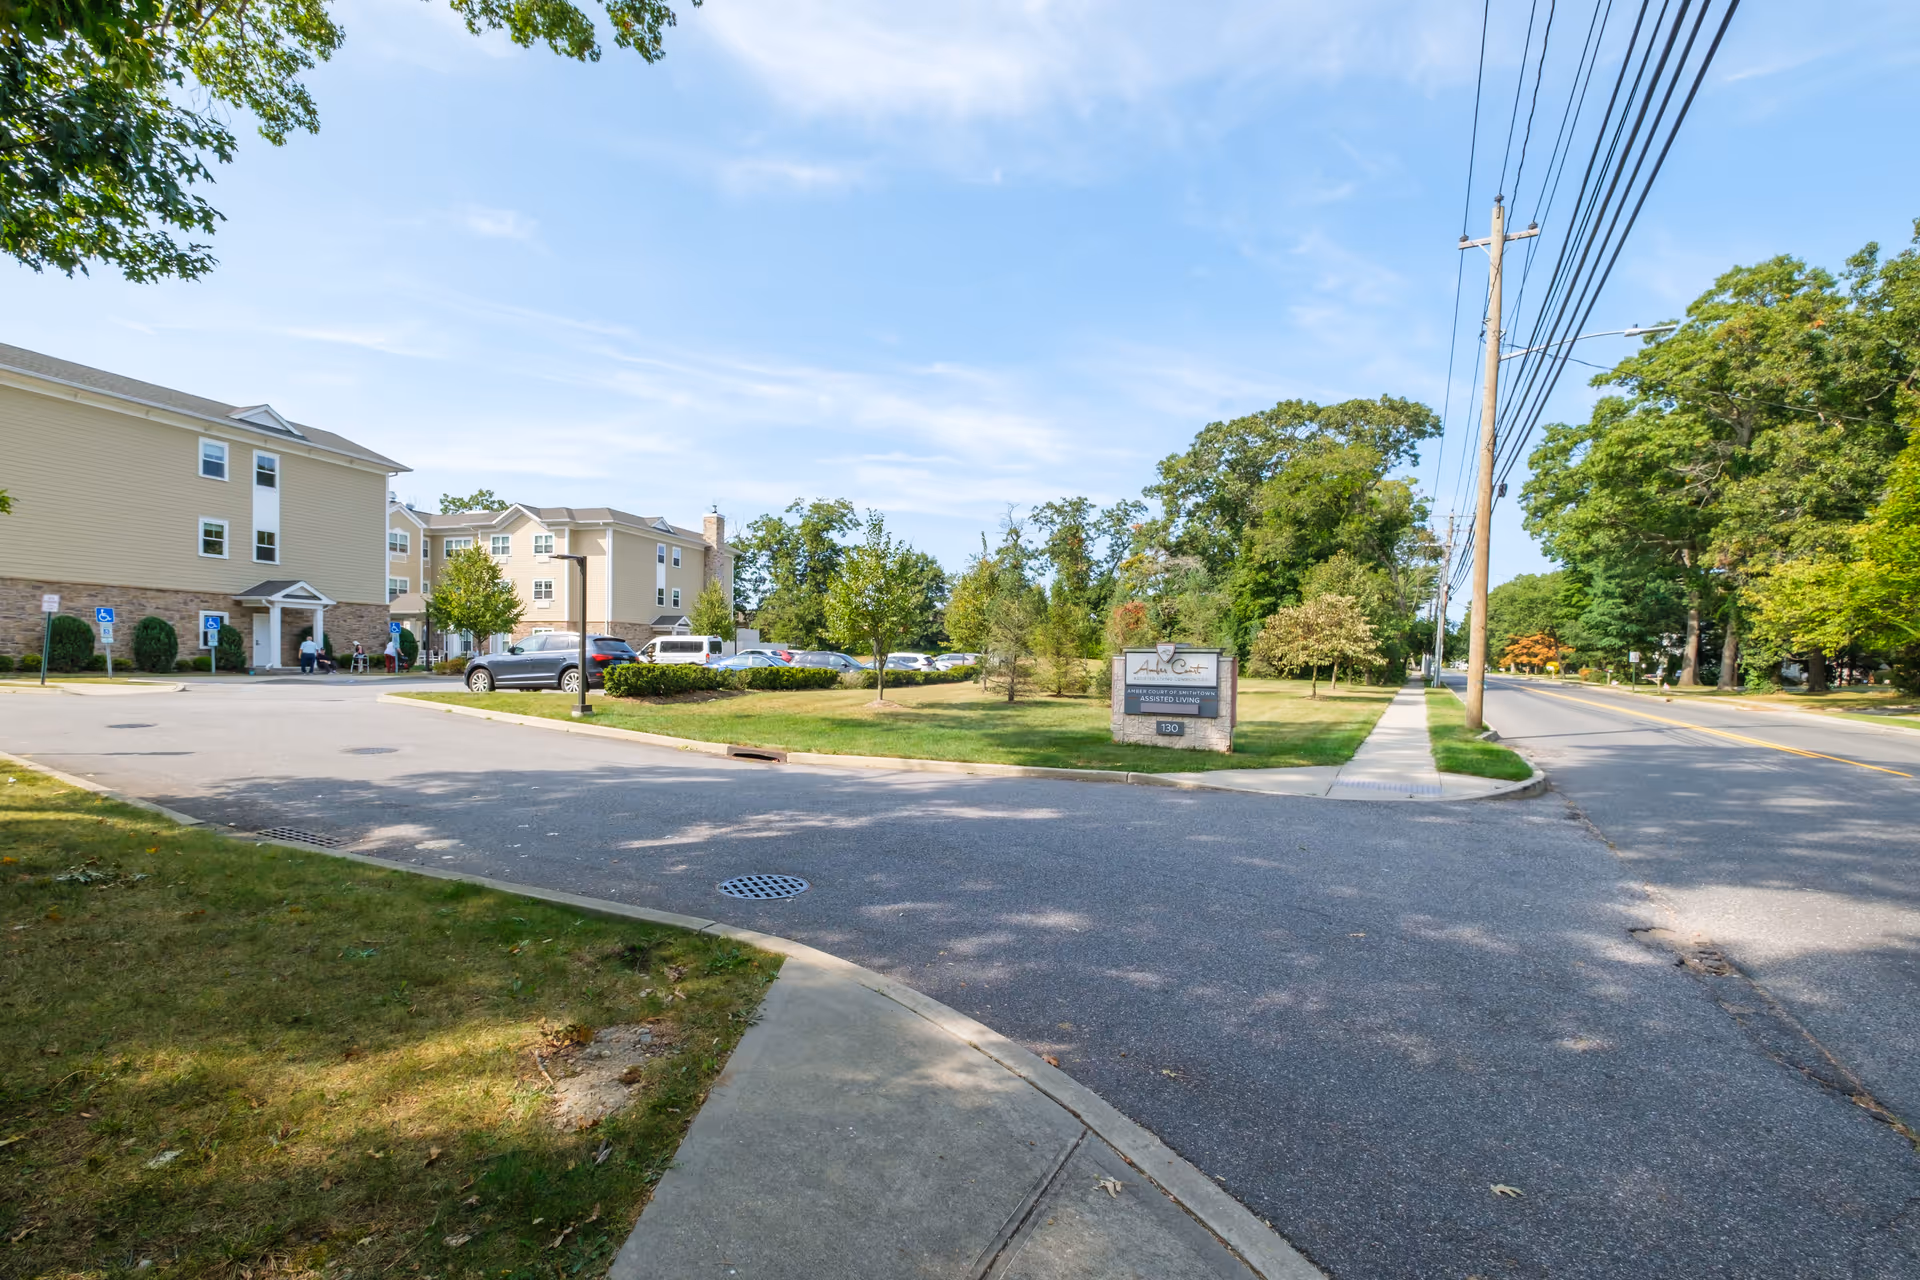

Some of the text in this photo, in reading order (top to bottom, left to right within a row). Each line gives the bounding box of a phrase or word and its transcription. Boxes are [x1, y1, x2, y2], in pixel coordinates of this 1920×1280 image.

[1133, 658, 1209, 675] Amber Court
[1140, 695, 1174, 703] ASSISTED
[1160, 723, 1179, 733] 130
